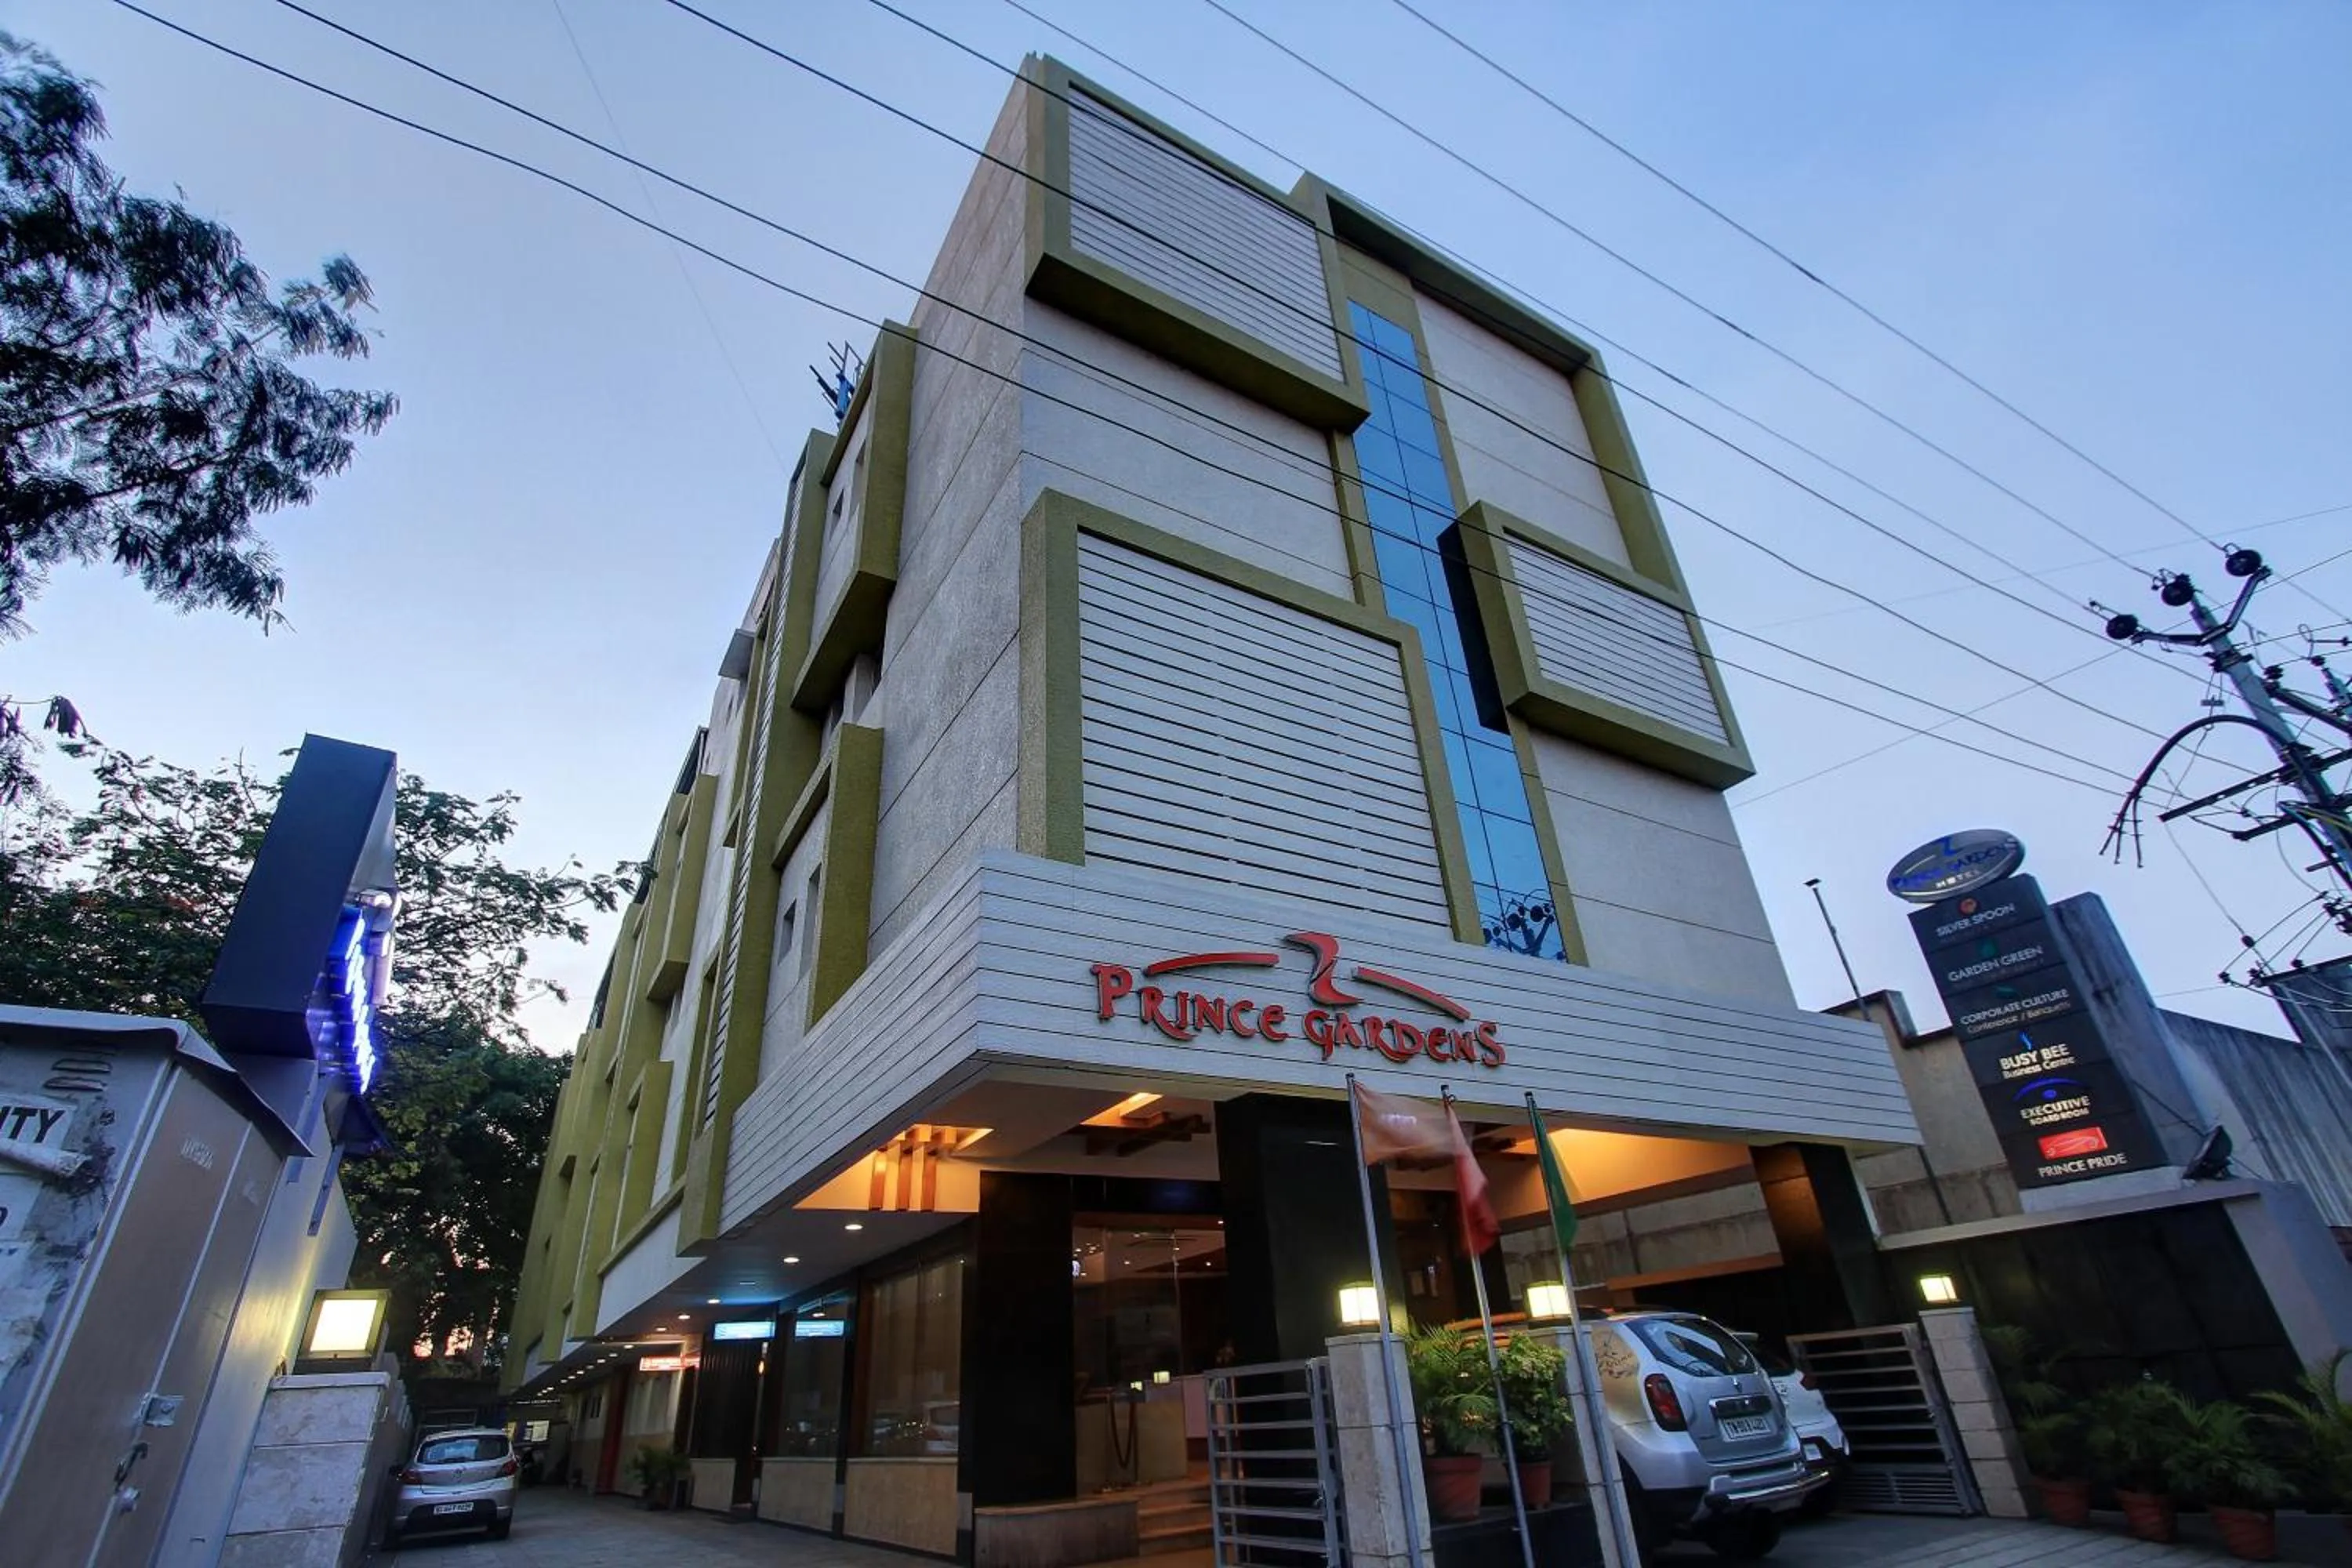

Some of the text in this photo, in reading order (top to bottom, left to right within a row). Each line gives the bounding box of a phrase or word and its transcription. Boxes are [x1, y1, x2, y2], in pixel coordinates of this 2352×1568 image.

[1936, 918, 1972, 937] SILVER
[1972, 902, 2016, 924] SPOON
[1948, 958, 2000, 981] GARDEN
[2001, 946, 2043, 965] GREEN
[1090, 964, 1506, 1067] PRINCE GARDENS
[1960, 989, 2069, 1025] CORPORATE CULTURE
[1999, 1044, 2070, 1070] BUSY BEE
[2002, 1056, 2075, 1079] Business Centre
[2020, 1095, 2091, 1119] EXECUTIVE
[2038, 1152, 2128, 1178] PRINCE PRIDE
